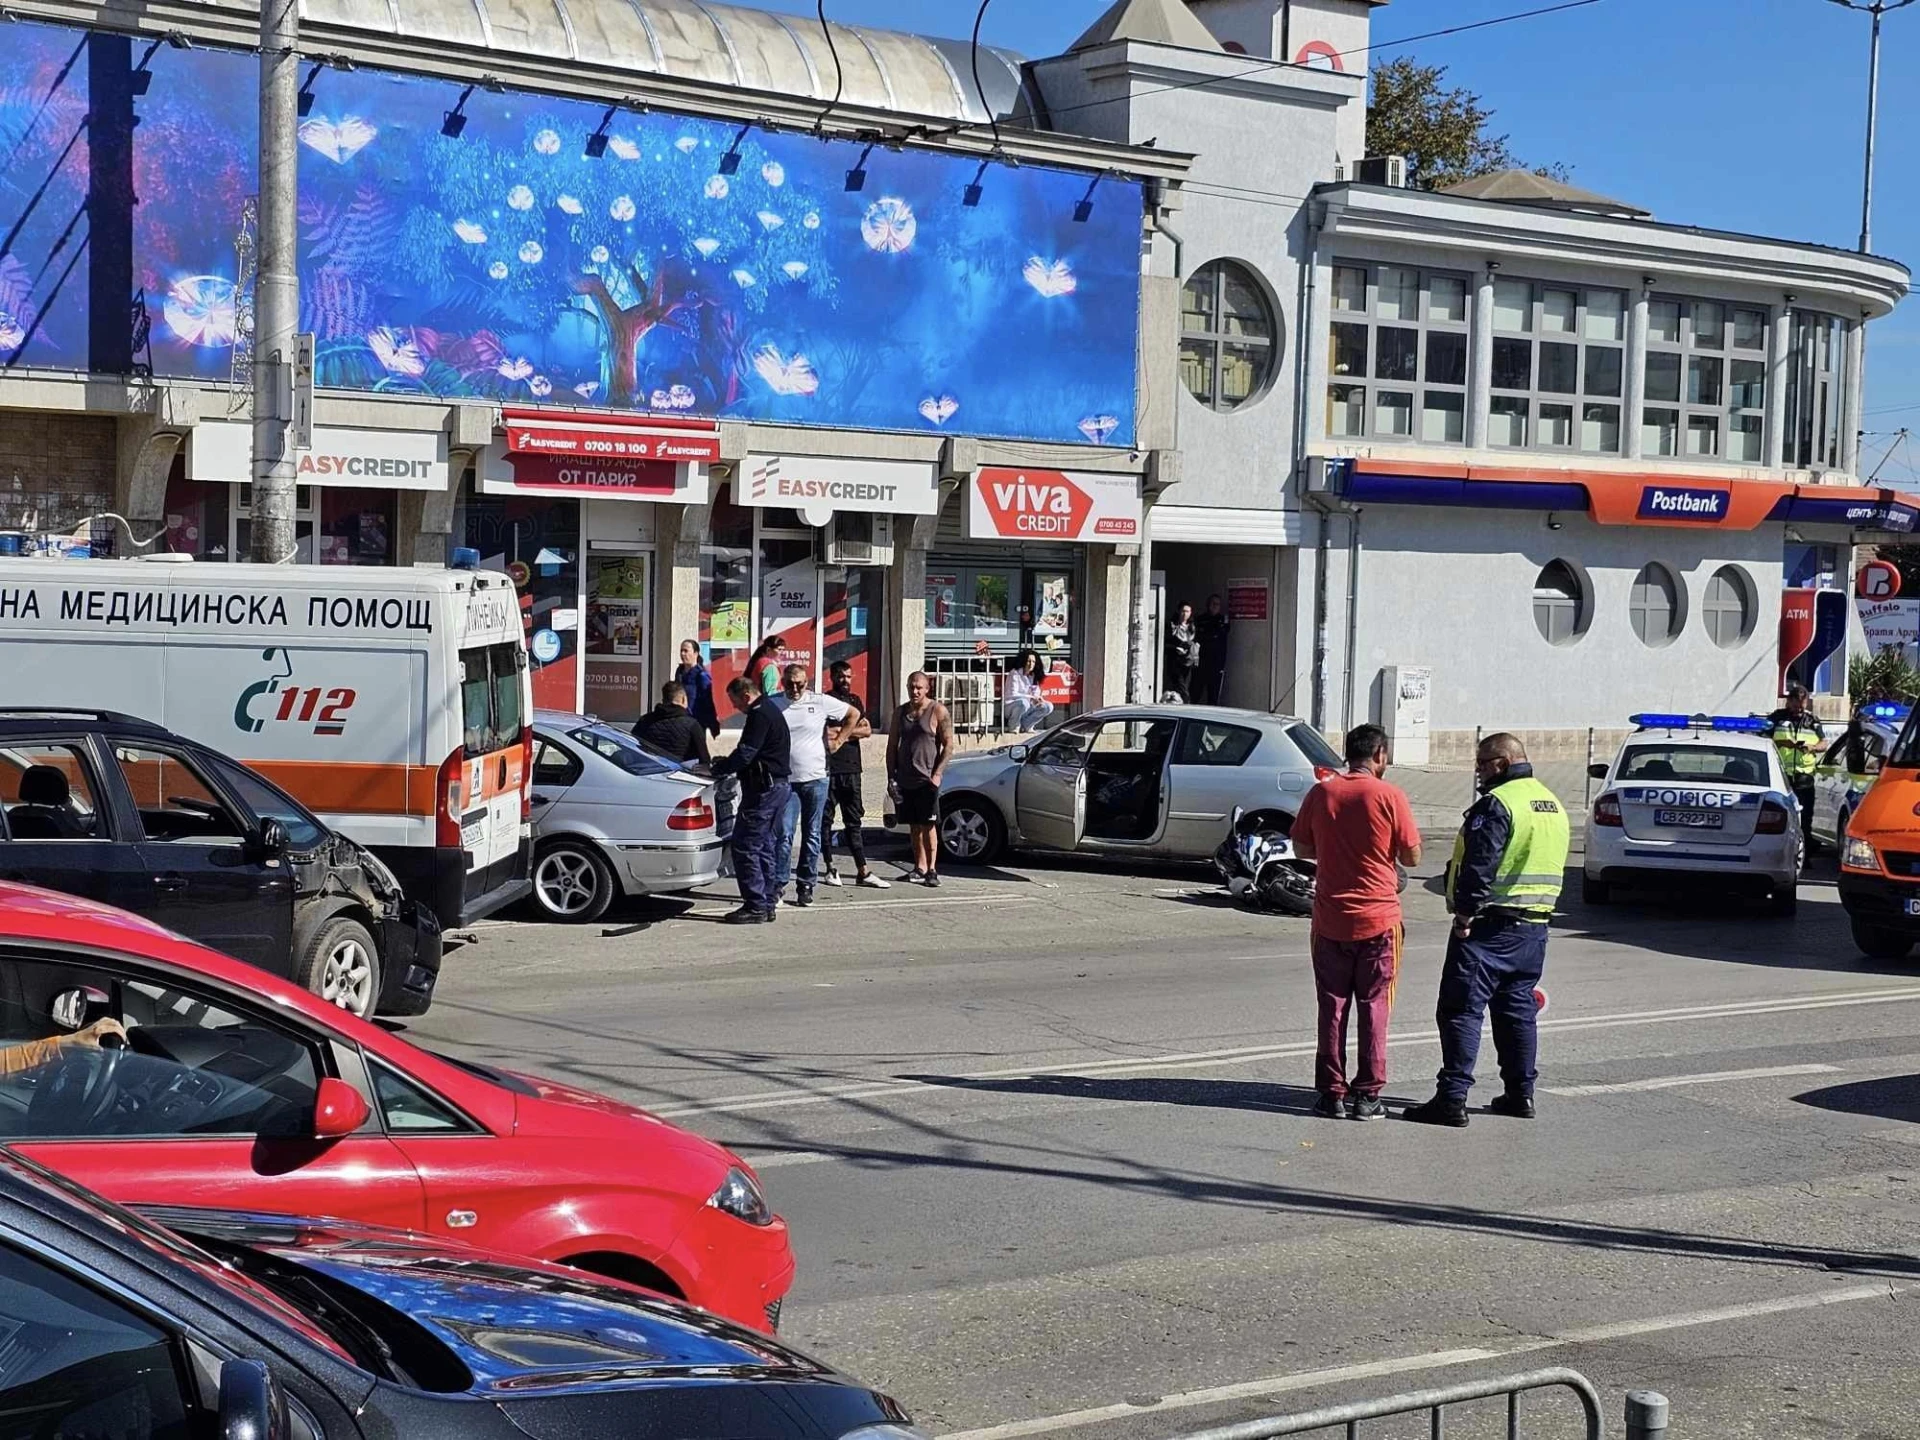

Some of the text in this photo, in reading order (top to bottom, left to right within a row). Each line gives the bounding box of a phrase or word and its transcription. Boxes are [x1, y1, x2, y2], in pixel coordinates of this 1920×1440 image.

[530, 438, 711, 456] EASYCREDIT 0700 18 100 EASYCREDIT
[298, 455, 432, 478] ASYCREDIT
[558, 469, 637, 487] ОТ ПАРИ?
[778, 479, 897, 501] EASYCREDIT
[992, 475, 1072, 514] viva
[1651, 490, 1719, 513] Postbank
[1016, 514, 1071, 532] CREDIT
[780, 592, 805, 600] EASY
[780, 600, 812, 609] CREDIT
[60, 590, 288, 627] МЕДИЦИНСКА
[308, 597, 432, 633] ПОМОЩ
[1786, 609, 1808, 619] ATM
[586, 674, 638, 684] 0700 18 100
[275, 686, 357, 722] 112
[1532, 801, 1558, 813] POLICE
[1646, 789, 1734, 808] POLICE
